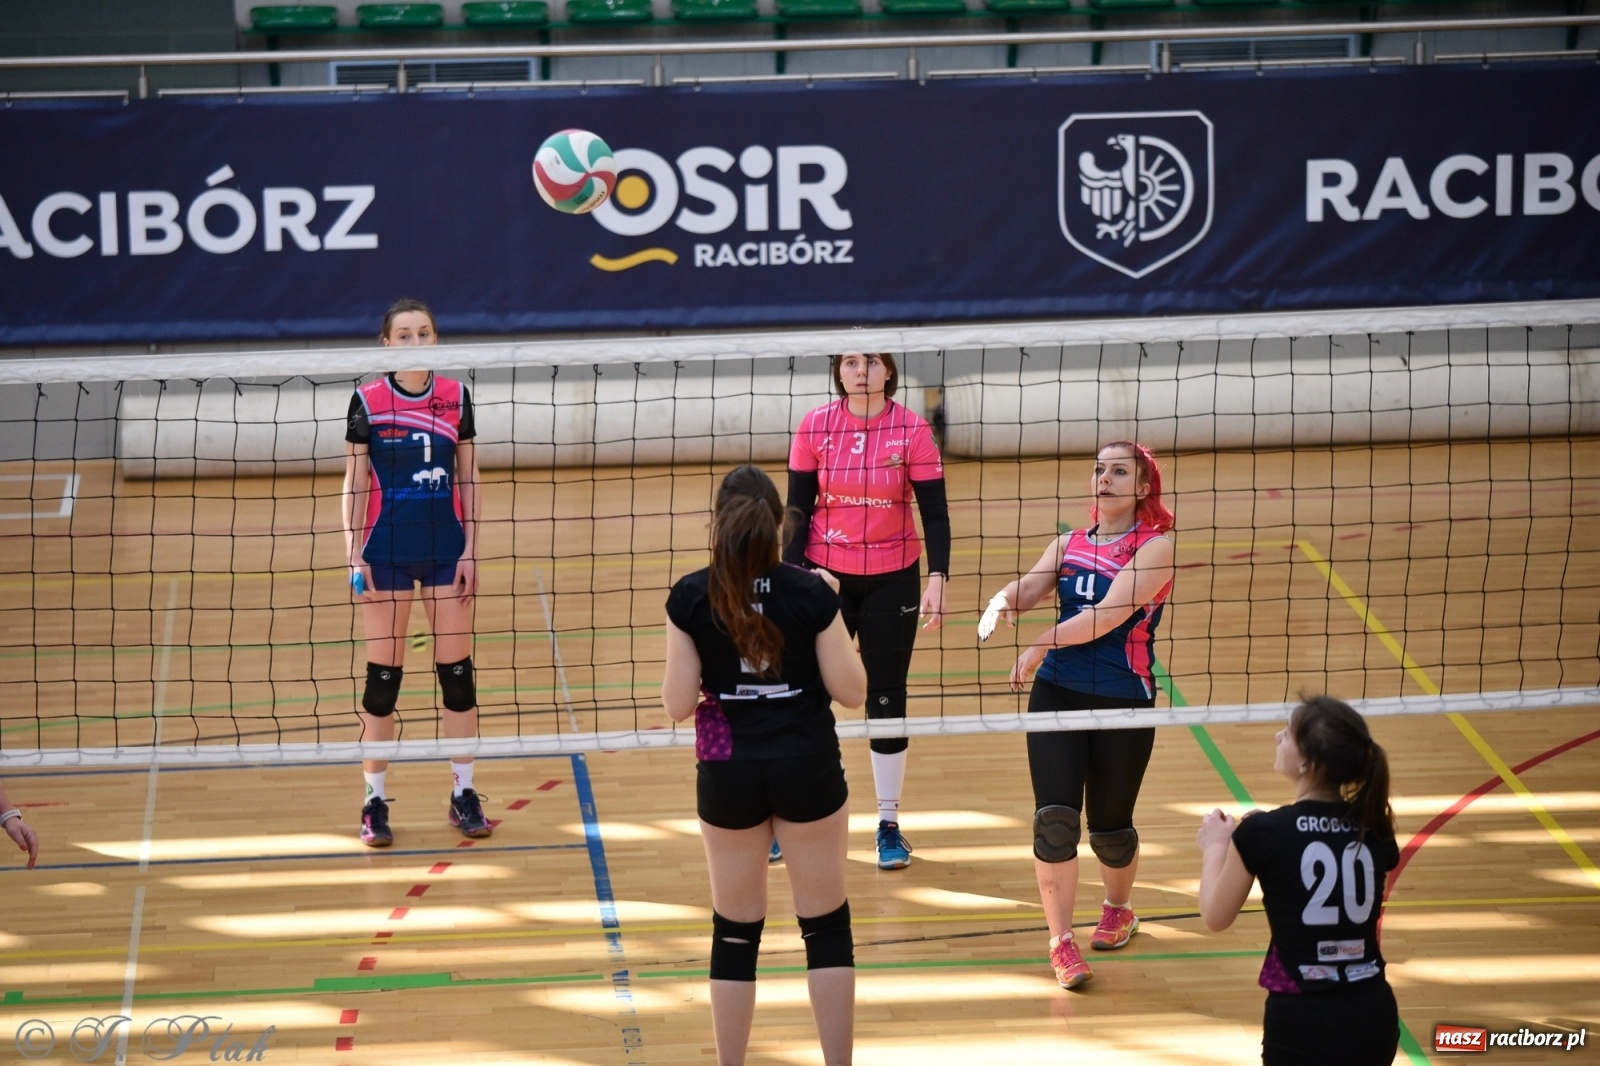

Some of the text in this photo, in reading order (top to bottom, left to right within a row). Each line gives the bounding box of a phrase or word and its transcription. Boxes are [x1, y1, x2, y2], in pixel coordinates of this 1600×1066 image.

[1306, 153, 1600, 222] RACIB
[694, 234, 854, 267] RACIBÓRZ
[412, 432, 432, 463] 7
[850, 432, 866, 454] 3
[836, 494, 892, 509] TAURON
[1075, 573, 1096, 600] 4
[1300, 840, 1375, 926] 20
